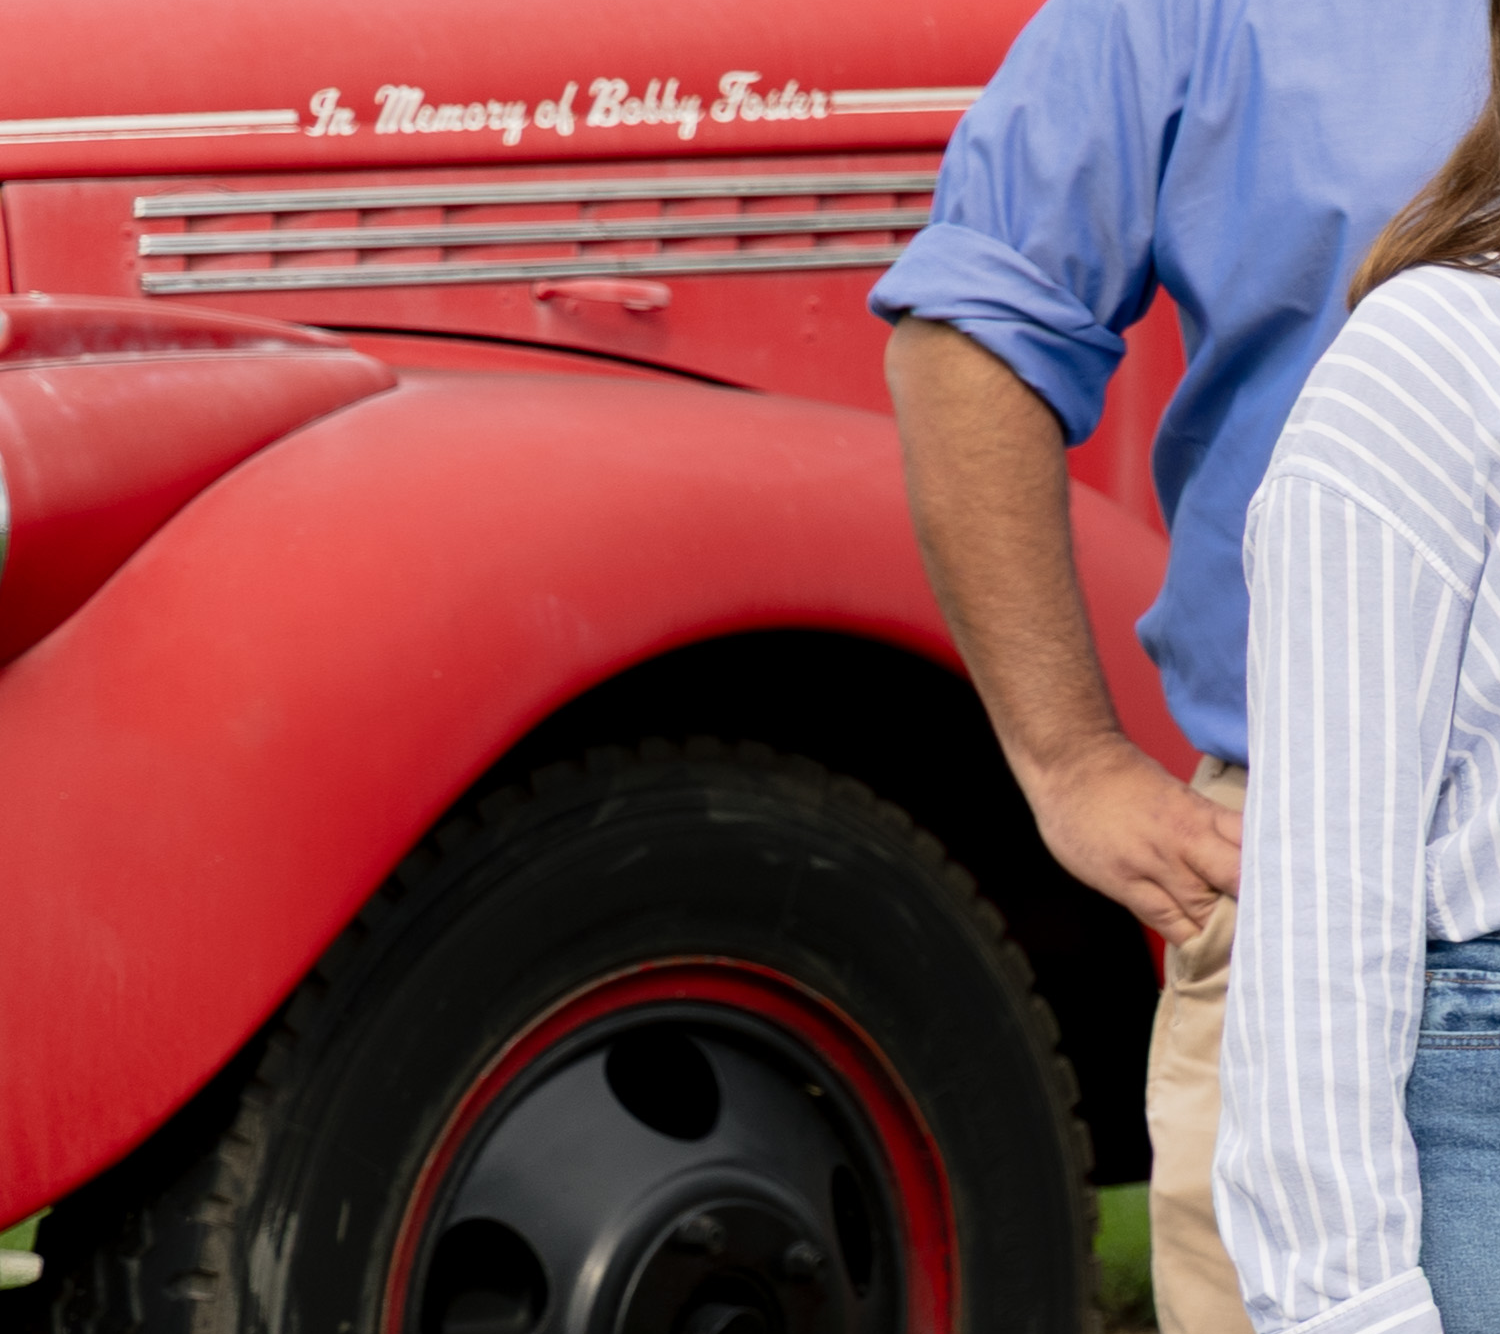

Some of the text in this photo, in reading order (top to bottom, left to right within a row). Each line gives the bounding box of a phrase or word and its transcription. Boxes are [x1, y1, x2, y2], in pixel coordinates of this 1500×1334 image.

[304, 70, 829, 146] In Memory of Bobby Foster
